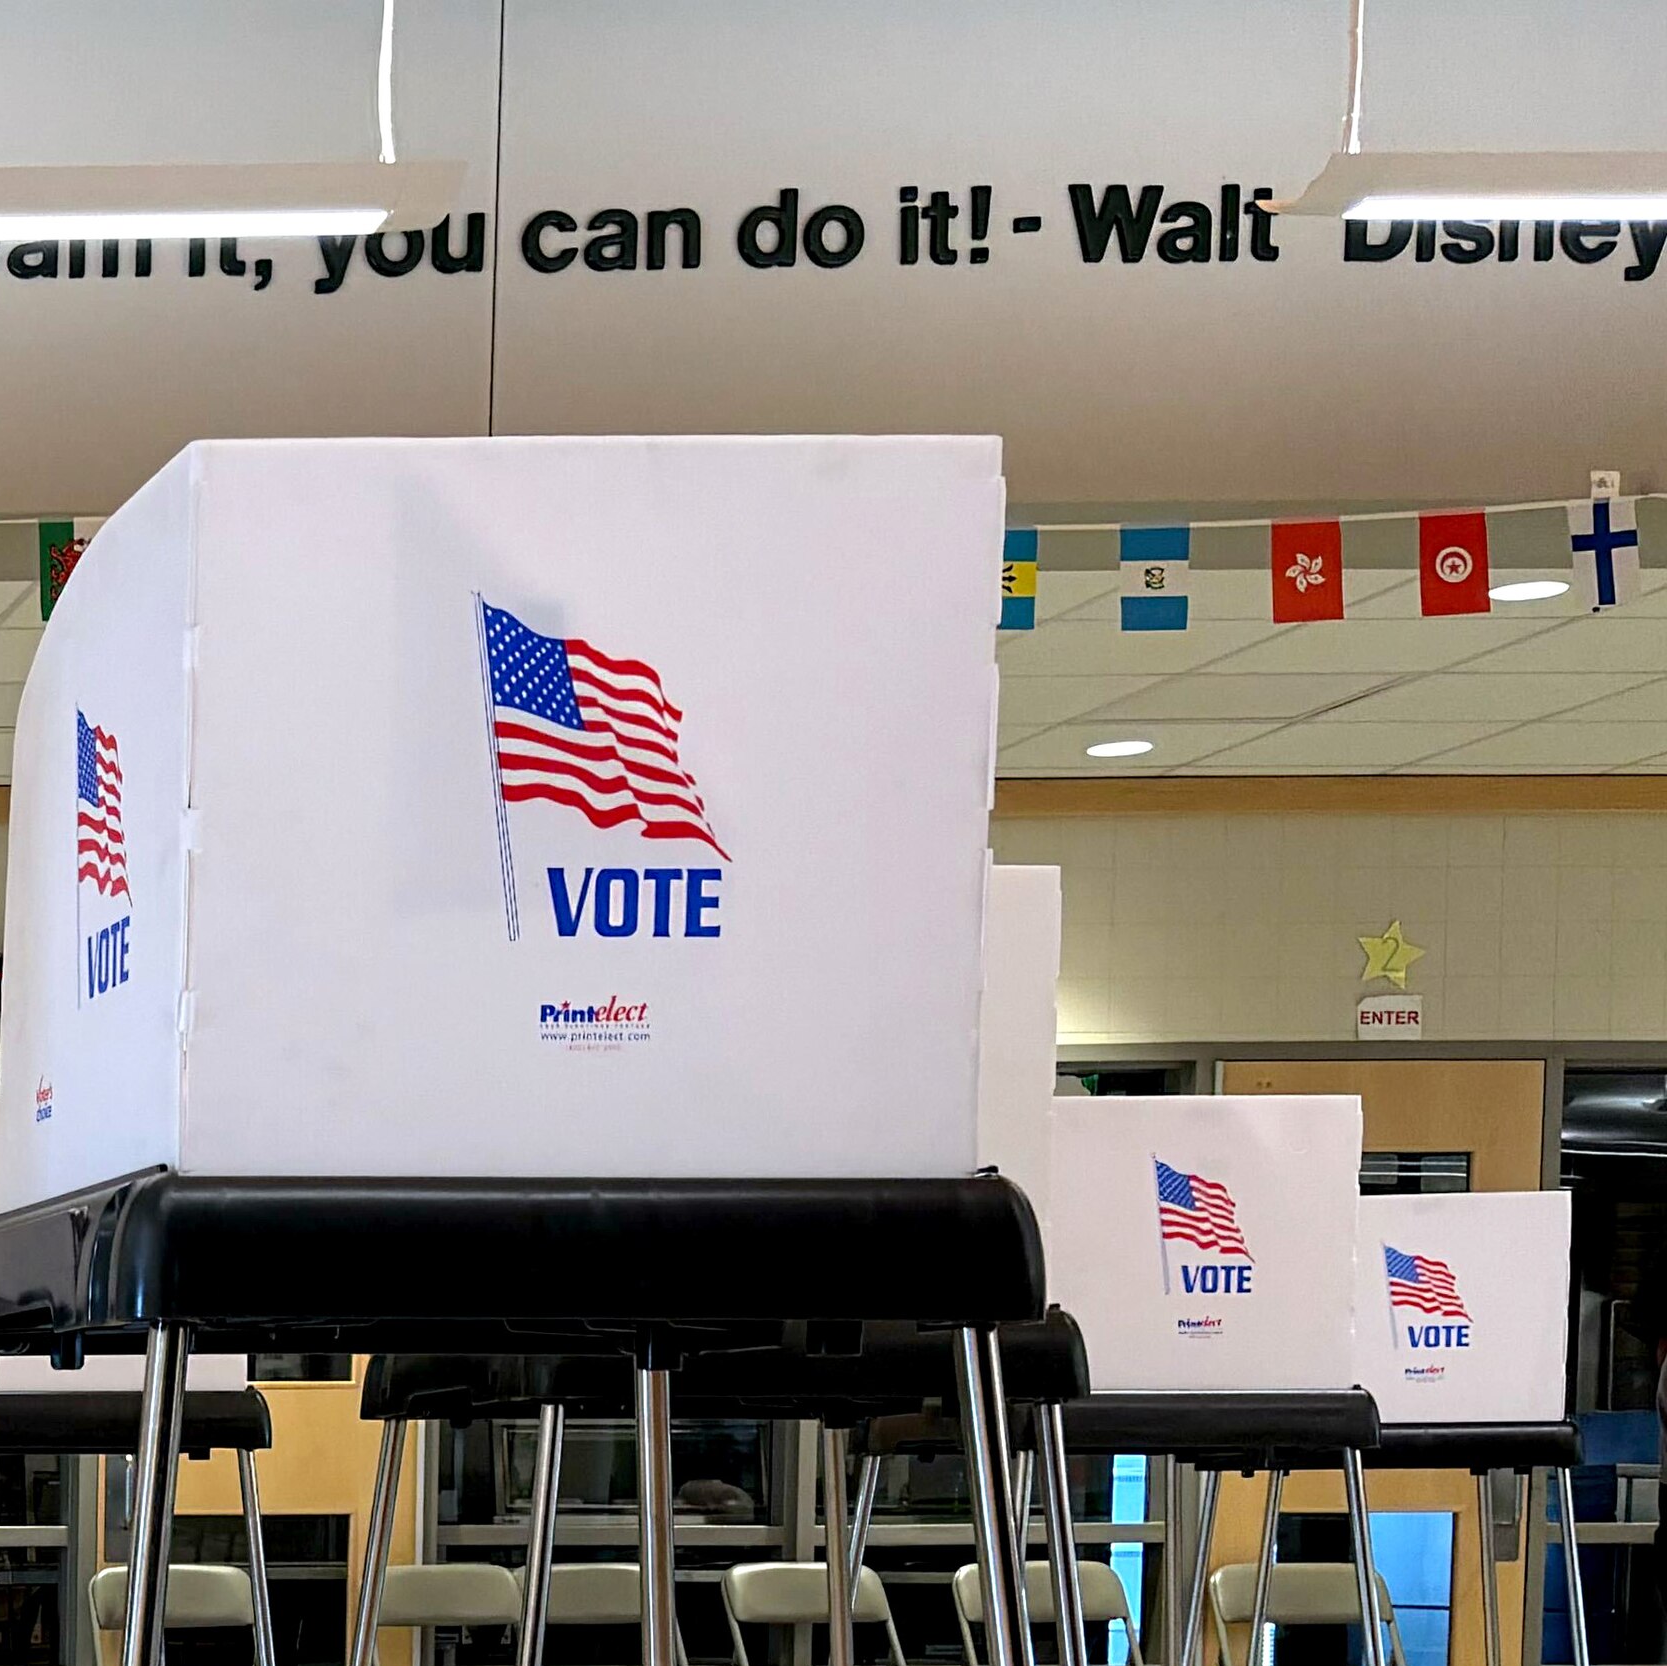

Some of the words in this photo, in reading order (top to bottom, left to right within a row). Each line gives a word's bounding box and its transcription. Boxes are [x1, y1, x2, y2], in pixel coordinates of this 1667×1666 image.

[314, 212, 485, 294] you
[521, 207, 701, 272] can
[737, 187, 865, 269] do
[1067, 183, 1280, 264] Walt
[547, 867, 723, 938] VOTE
[87, 915, 131, 1000] VOTE
[1381, 936, 1404, 972] 2
[540, 994, 649, 1023] Printelect
[1359, 1010, 1420, 1026] ENTER
[1181, 1264, 1252, 1294] VOTE
[1407, 1325, 1470, 1348] VOTE
